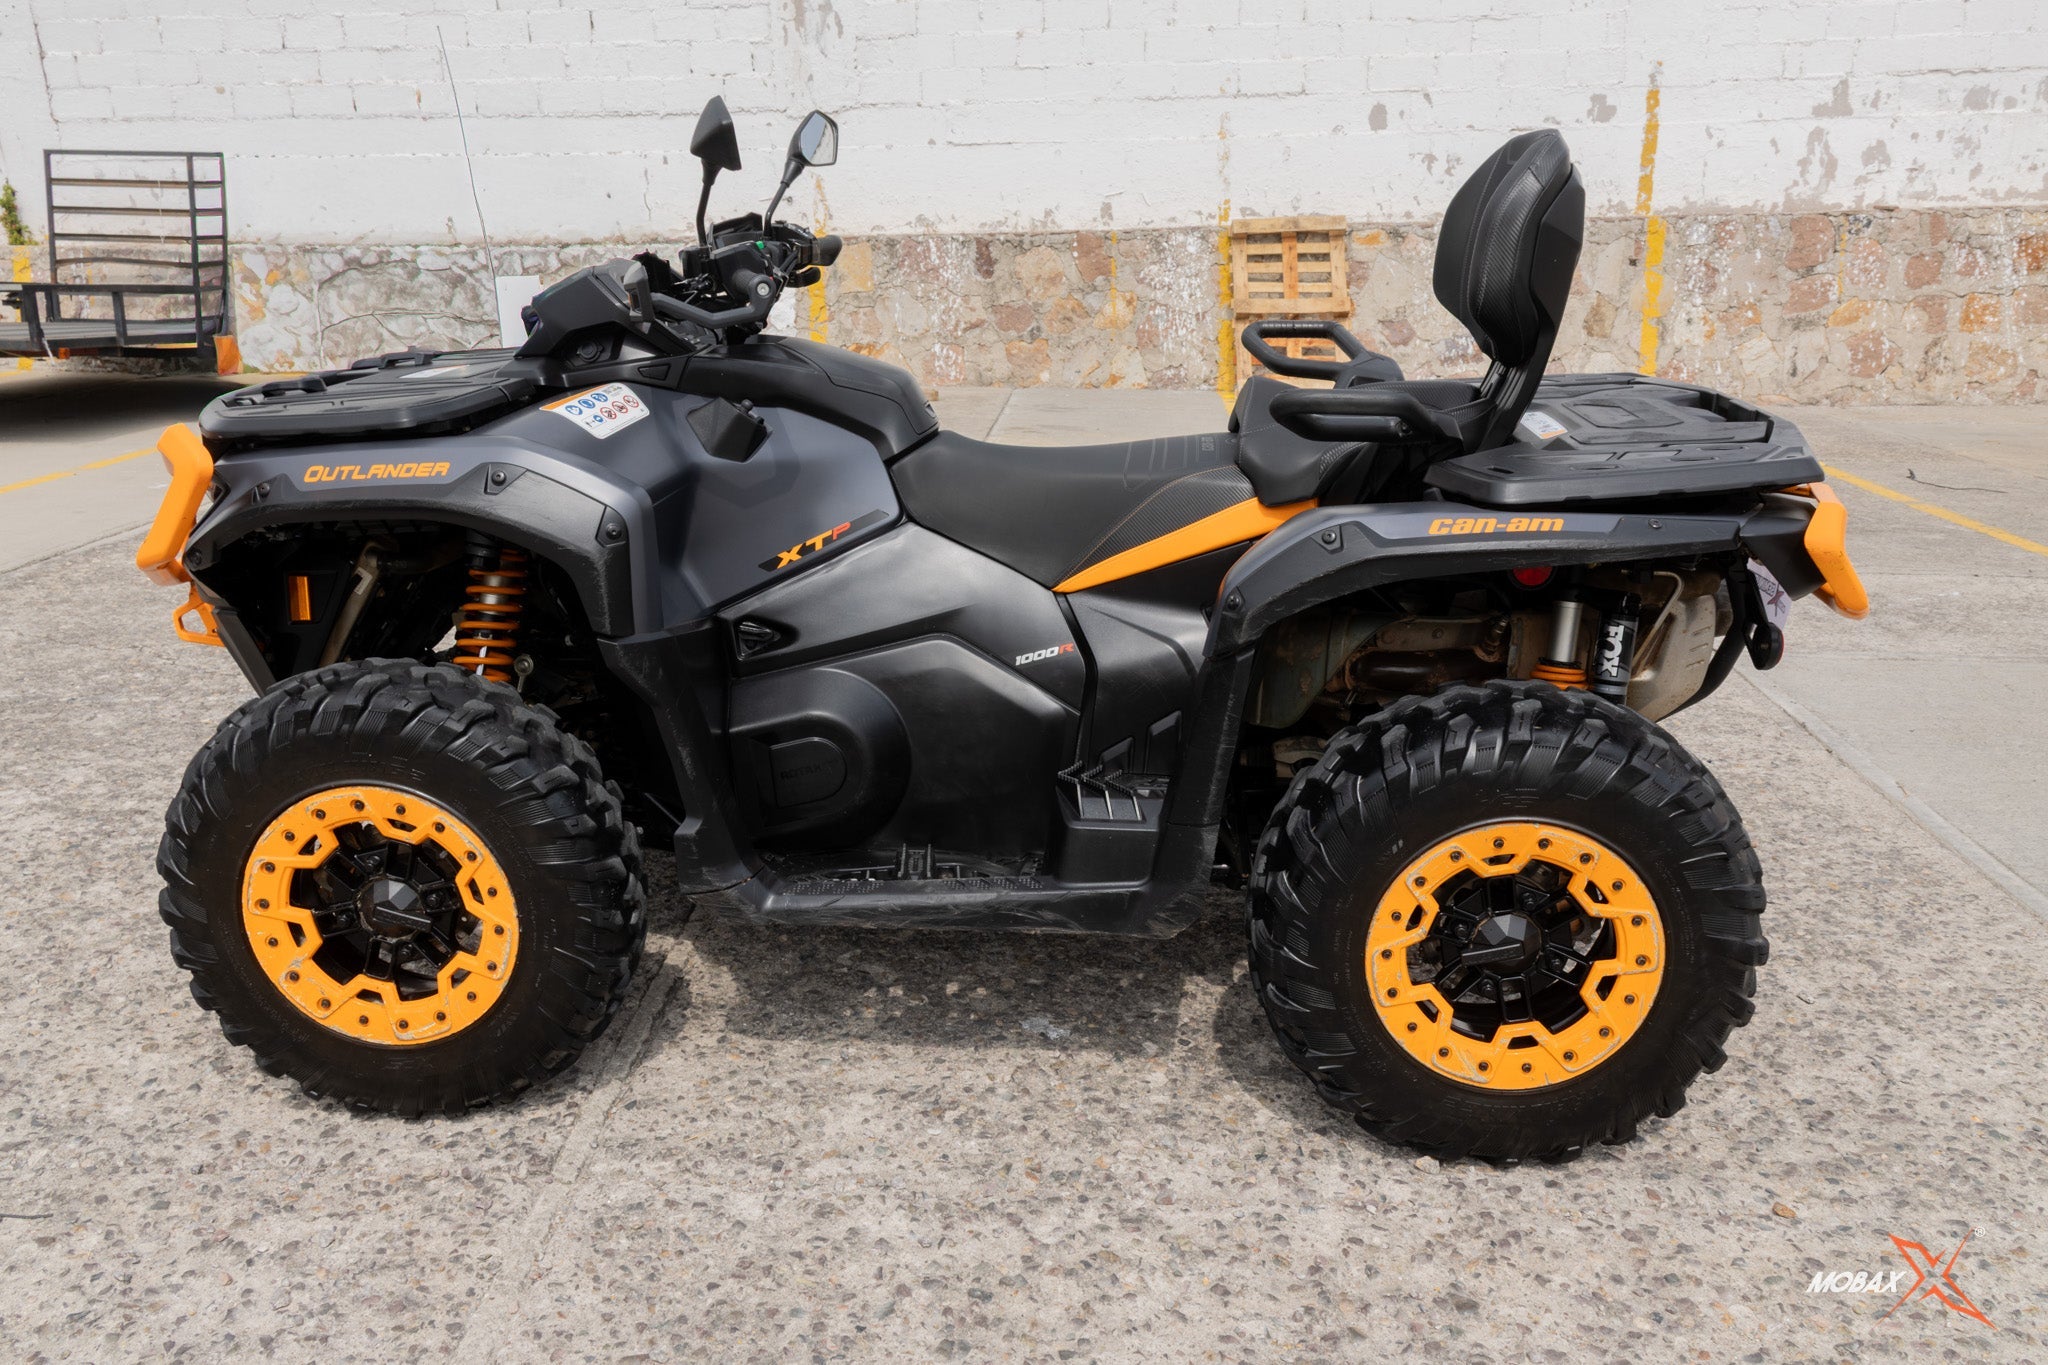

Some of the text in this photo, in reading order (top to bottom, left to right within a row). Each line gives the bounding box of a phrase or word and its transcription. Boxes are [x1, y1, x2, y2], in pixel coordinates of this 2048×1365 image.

[303, 461, 451, 483] OUTLANDER
[1428, 517, 1565, 535] can-am
[777, 521, 851, 569] XTP
[1015, 642, 1075, 666] 1000R
[1601, 625, 1625, 677] FOX
